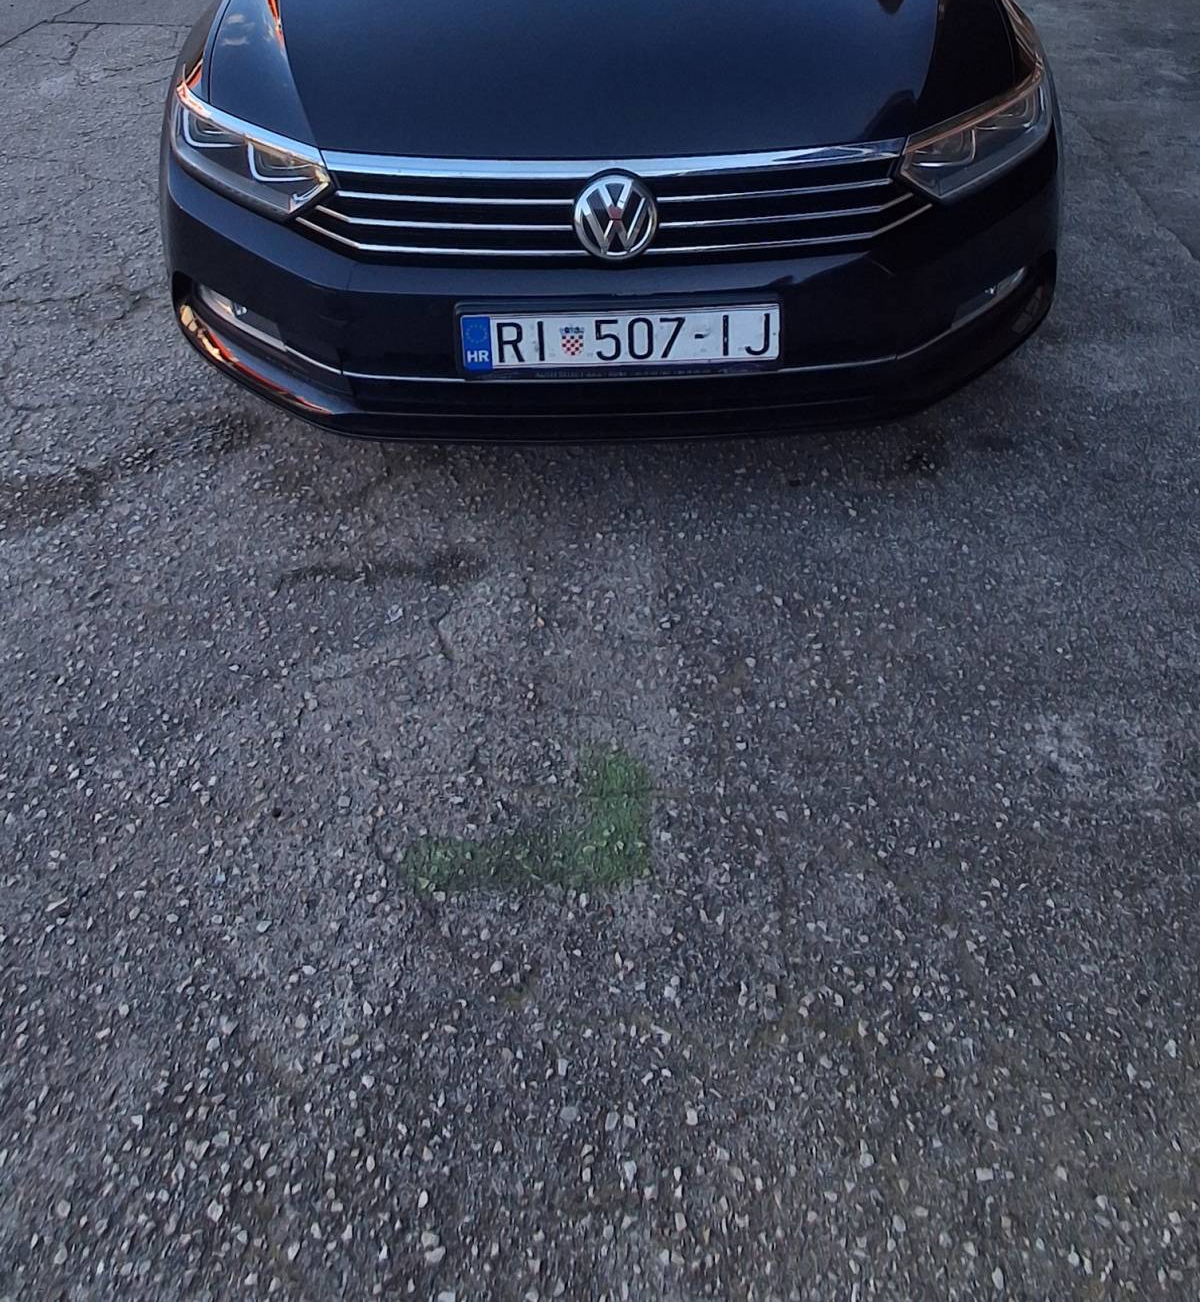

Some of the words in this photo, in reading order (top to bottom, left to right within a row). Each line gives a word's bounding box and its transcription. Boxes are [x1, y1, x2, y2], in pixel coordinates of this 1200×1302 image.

[577, 176, 654, 257] VW
[466, 350, 490, 363] HR
[496, 320, 546, 363] RI
